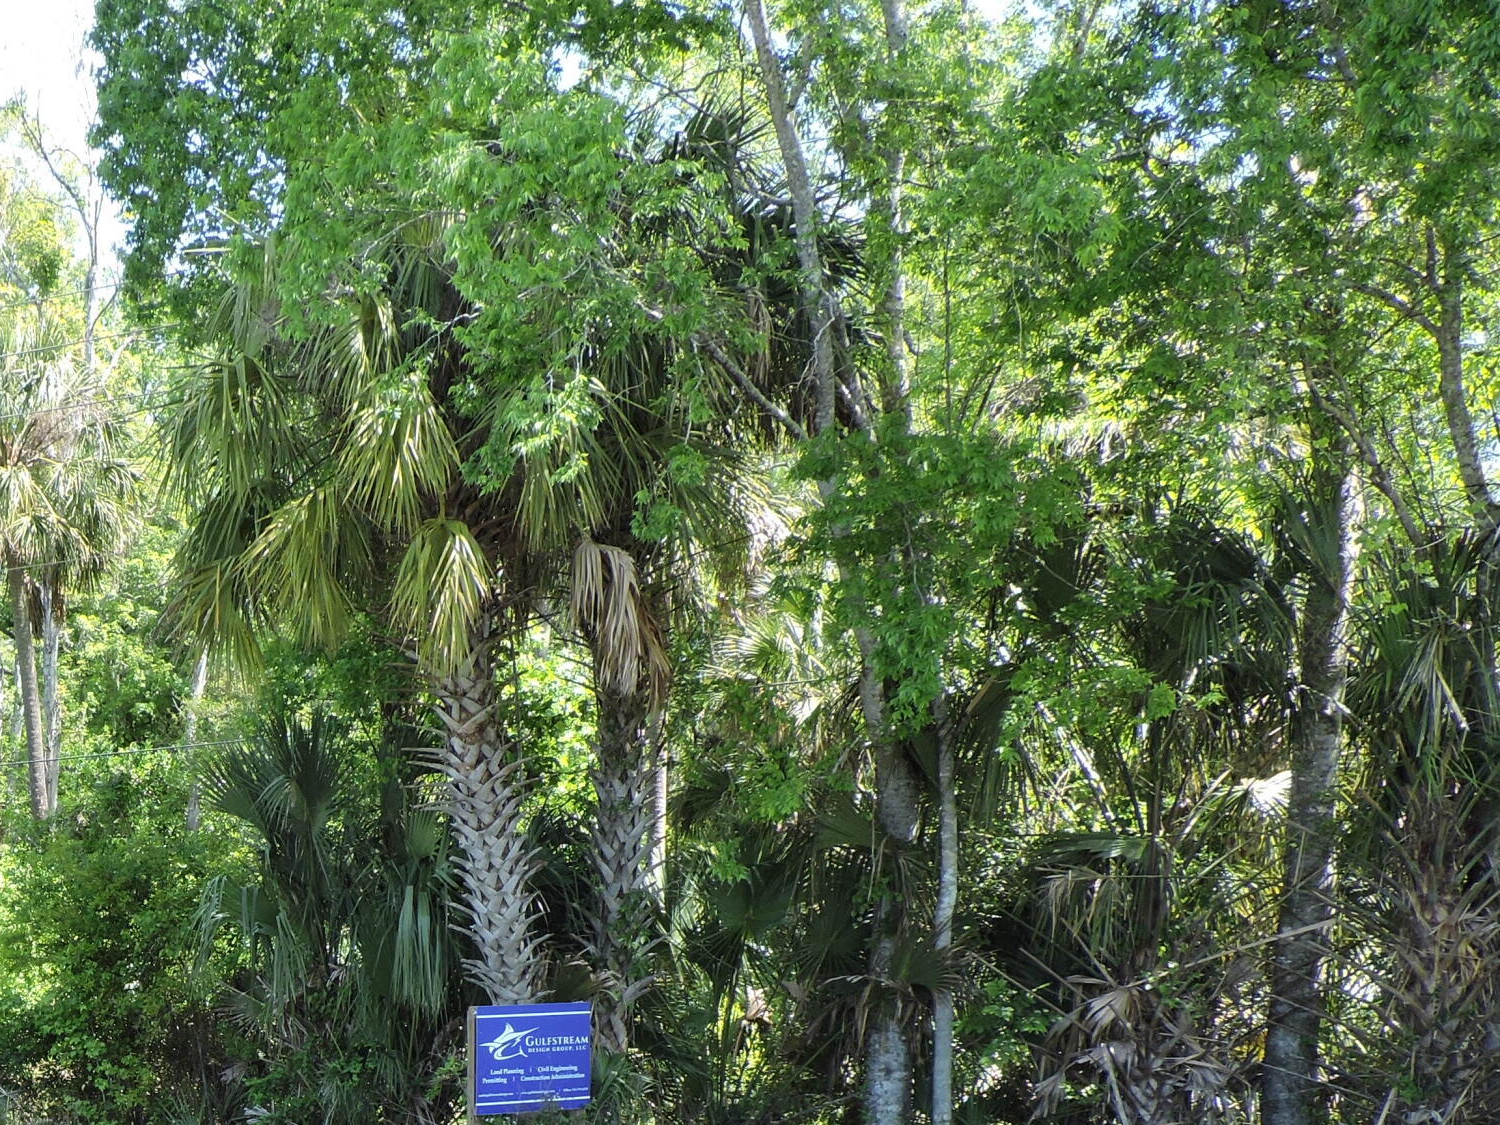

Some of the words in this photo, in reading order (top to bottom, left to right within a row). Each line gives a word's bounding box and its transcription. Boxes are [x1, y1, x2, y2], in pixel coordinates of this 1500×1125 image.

[525, 1035, 589, 1047] GULFSTREAM
[503, 1067, 525, 1075] Planning
[550, 1064, 578, 1073] Engineering
